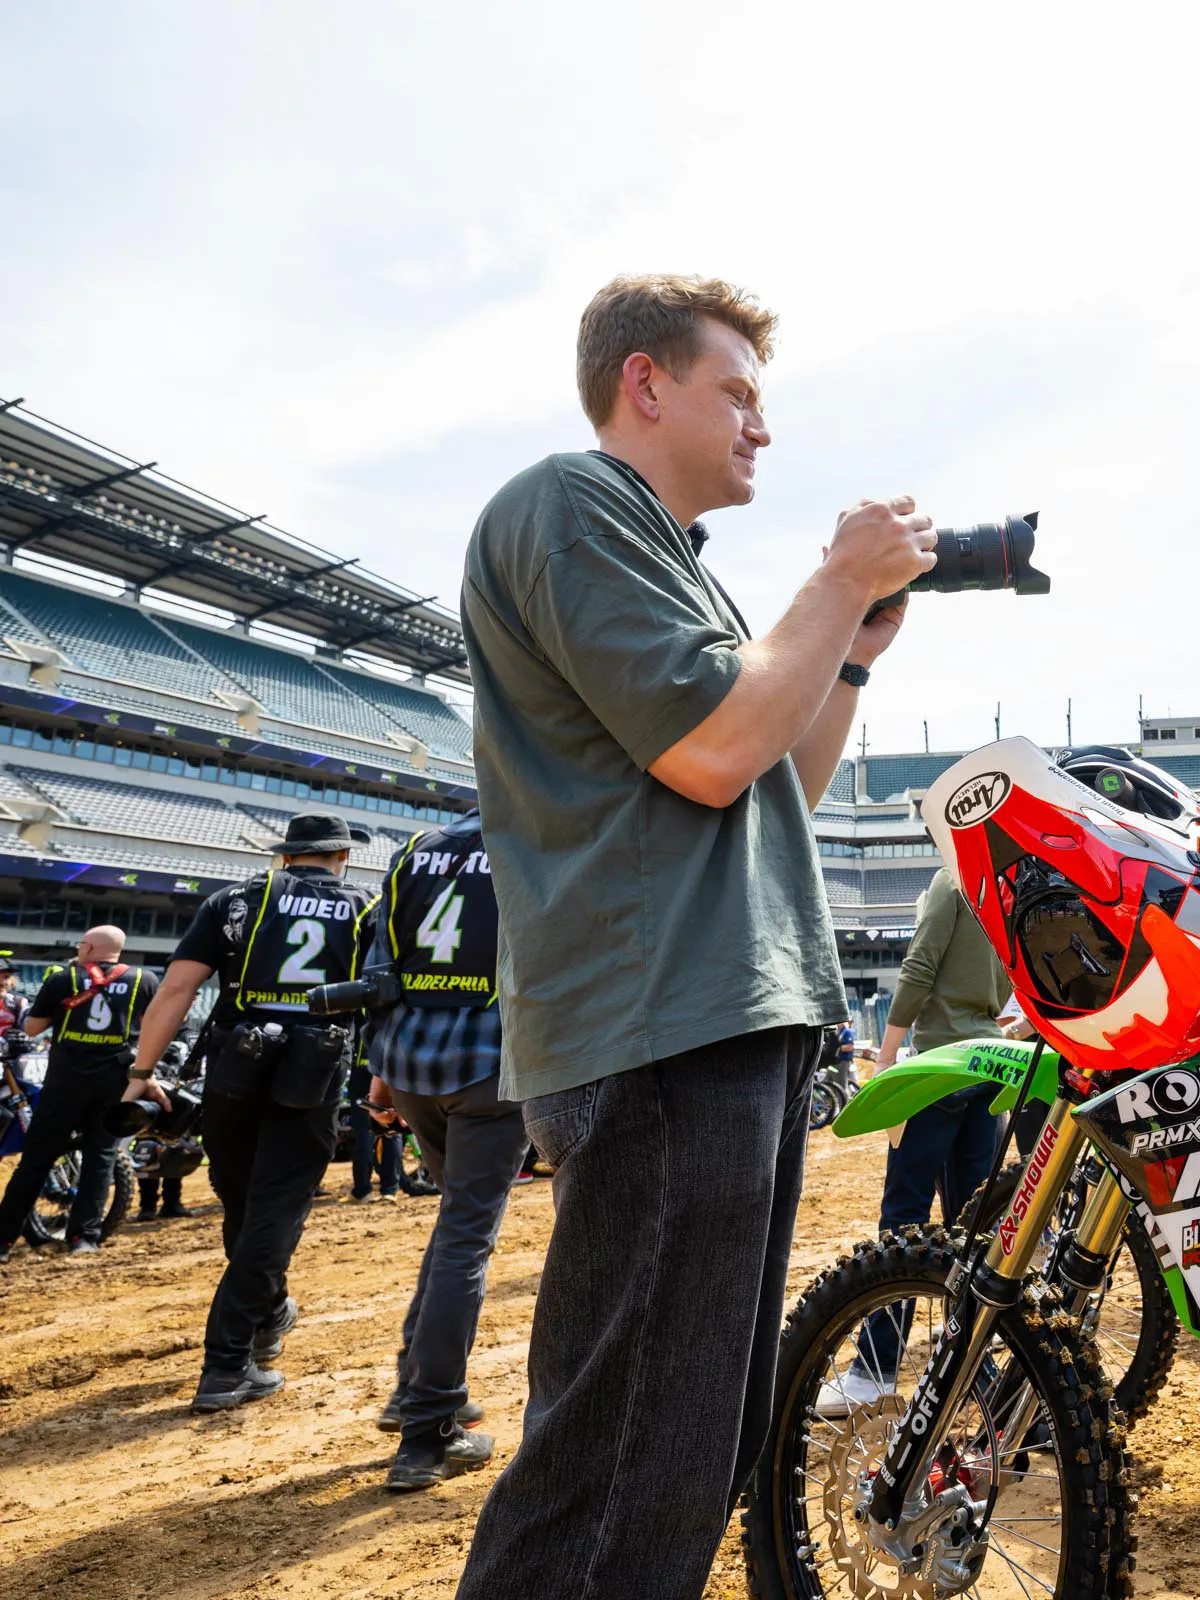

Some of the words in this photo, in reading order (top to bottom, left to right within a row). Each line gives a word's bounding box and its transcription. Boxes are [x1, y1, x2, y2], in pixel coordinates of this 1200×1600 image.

[952, 773, 1002, 826] Arai
[411, 851, 492, 876] PHTO
[278, 894, 350, 920] VIDEO
[416, 879, 465, 963] 4
[277, 918, 326, 984] 2
[83, 978, 128, 994] PTO
[87, 993, 112, 1031] 9
[1012, 1122, 1060, 1221] SHOWA
[911, 1386, 942, 1436] OFF
